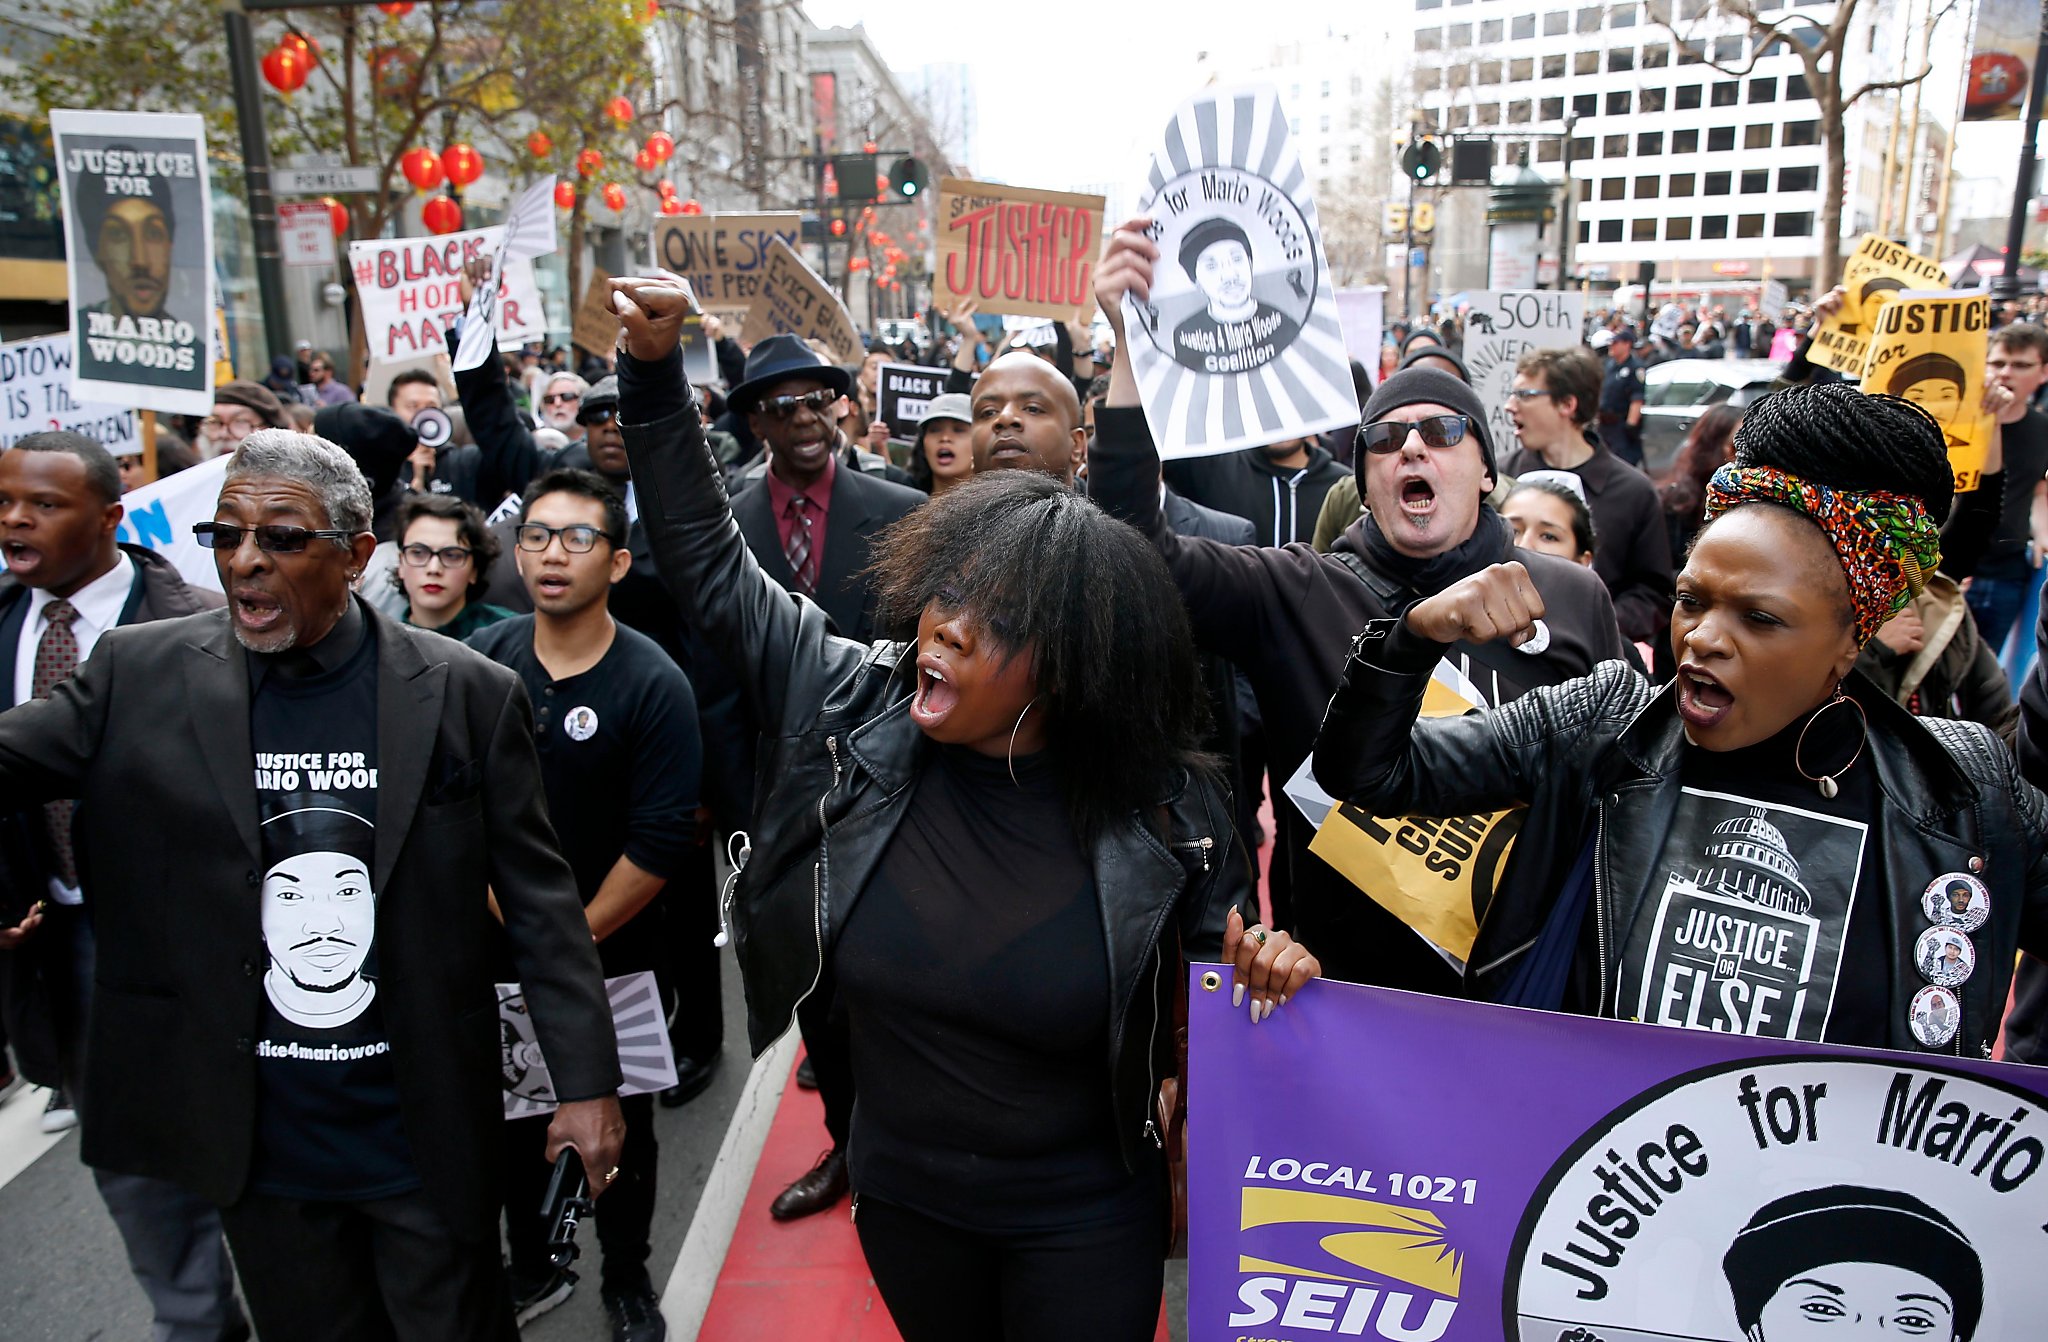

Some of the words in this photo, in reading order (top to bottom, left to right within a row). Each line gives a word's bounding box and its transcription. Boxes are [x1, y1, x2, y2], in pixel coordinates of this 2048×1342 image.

[66, 149, 196, 178] JUSTICE
[105, 175, 152, 196] FOR
[294, 174, 358, 189] POWELL
[1165, 186, 1189, 216] for
[1201, 174, 1250, 205] Mario
[1257, 187, 1303, 261] Woods
[1385, 202, 1435, 232] 50
[355, 237, 485, 289] #BLACK
[665, 228, 728, 271] ONE
[689, 274, 713, 298] NE
[723, 274, 762, 298] PEO
[769, 254, 816, 310] EVICT
[87, 311, 195, 345] MARIO
[388, 301, 526, 355] MATR
[1497, 293, 1571, 330] 50th
[87, 336, 195, 372] WOODS
[1205, 343, 1275, 372] Coalition
[1818, 331, 1867, 356] MARI
[1, 346, 71, 381] DTOW
[889, 374, 931, 395] BLACK
[328, 752, 365, 769] FOR
[254, 769, 300, 791] RIO
[1424, 813, 1493, 882] SUH
[1718, 958, 1735, 977] OR
[256, 1039, 389, 1061] tice4mariowoo
[1244, 1155, 1379, 1194] LOCAL
[1388, 1172, 1477, 1205] 1021
[1541, 1123, 1709, 1301] Justice
[1737, 1073, 1827, 1150] for
[1876, 1072, 2045, 1194] Mario
[1228, 1276, 1459, 1342] SEIU
